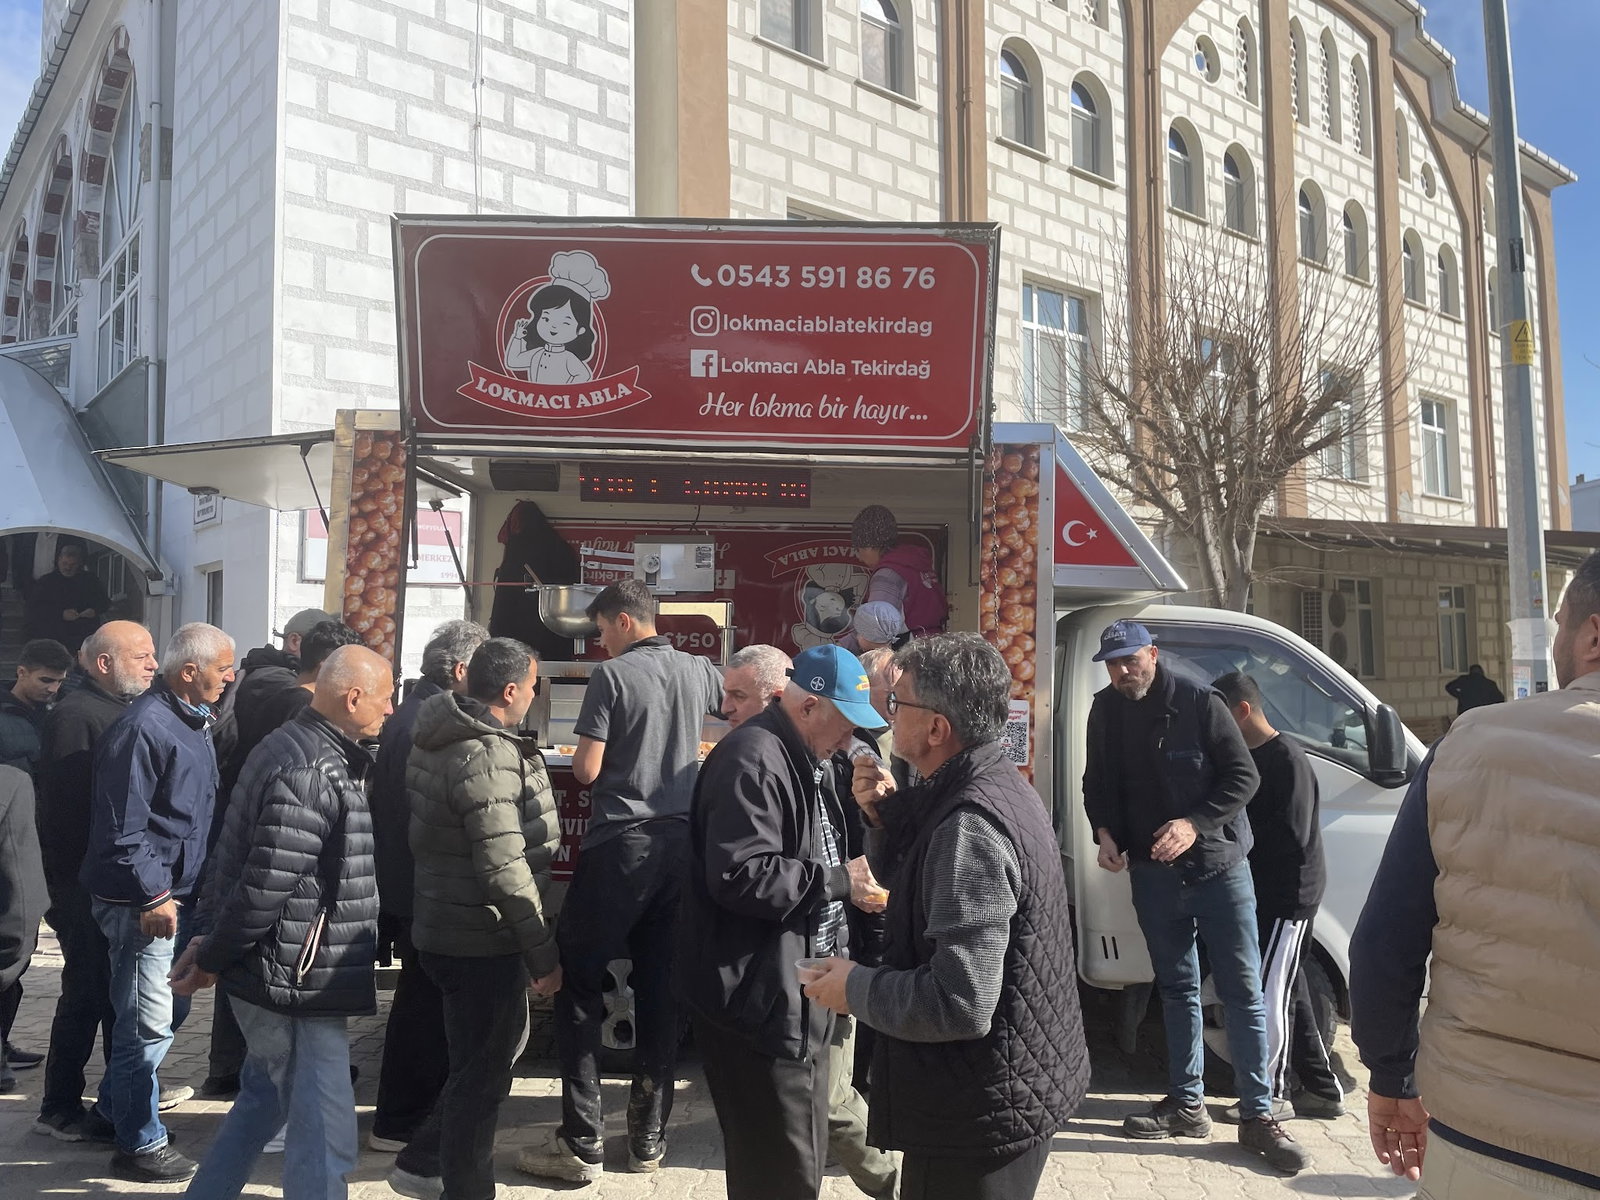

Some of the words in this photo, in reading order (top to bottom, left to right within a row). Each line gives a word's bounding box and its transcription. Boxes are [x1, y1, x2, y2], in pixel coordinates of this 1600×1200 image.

[717, 264, 791, 288] 0543
[800, 265, 846, 289] 591
[856, 266, 892, 289] 86
[902, 266, 936, 290] 76
[723, 313, 933, 337] lokmaciablatekirdag
[721, 357, 798, 374] Lokmacı
[803, 359, 846, 375] Abla
[851, 359, 931, 380] Tekirdağ
[475, 376, 571, 409] LOKMACI
[576, 383, 633, 408] ABLA
[698, 391, 744, 417] Her
[749, 392, 813, 419] lokma
[818, 393, 849, 419] bir
[853, 394, 929, 425] hayır...
[778, 546, 821, 566] ABLA
